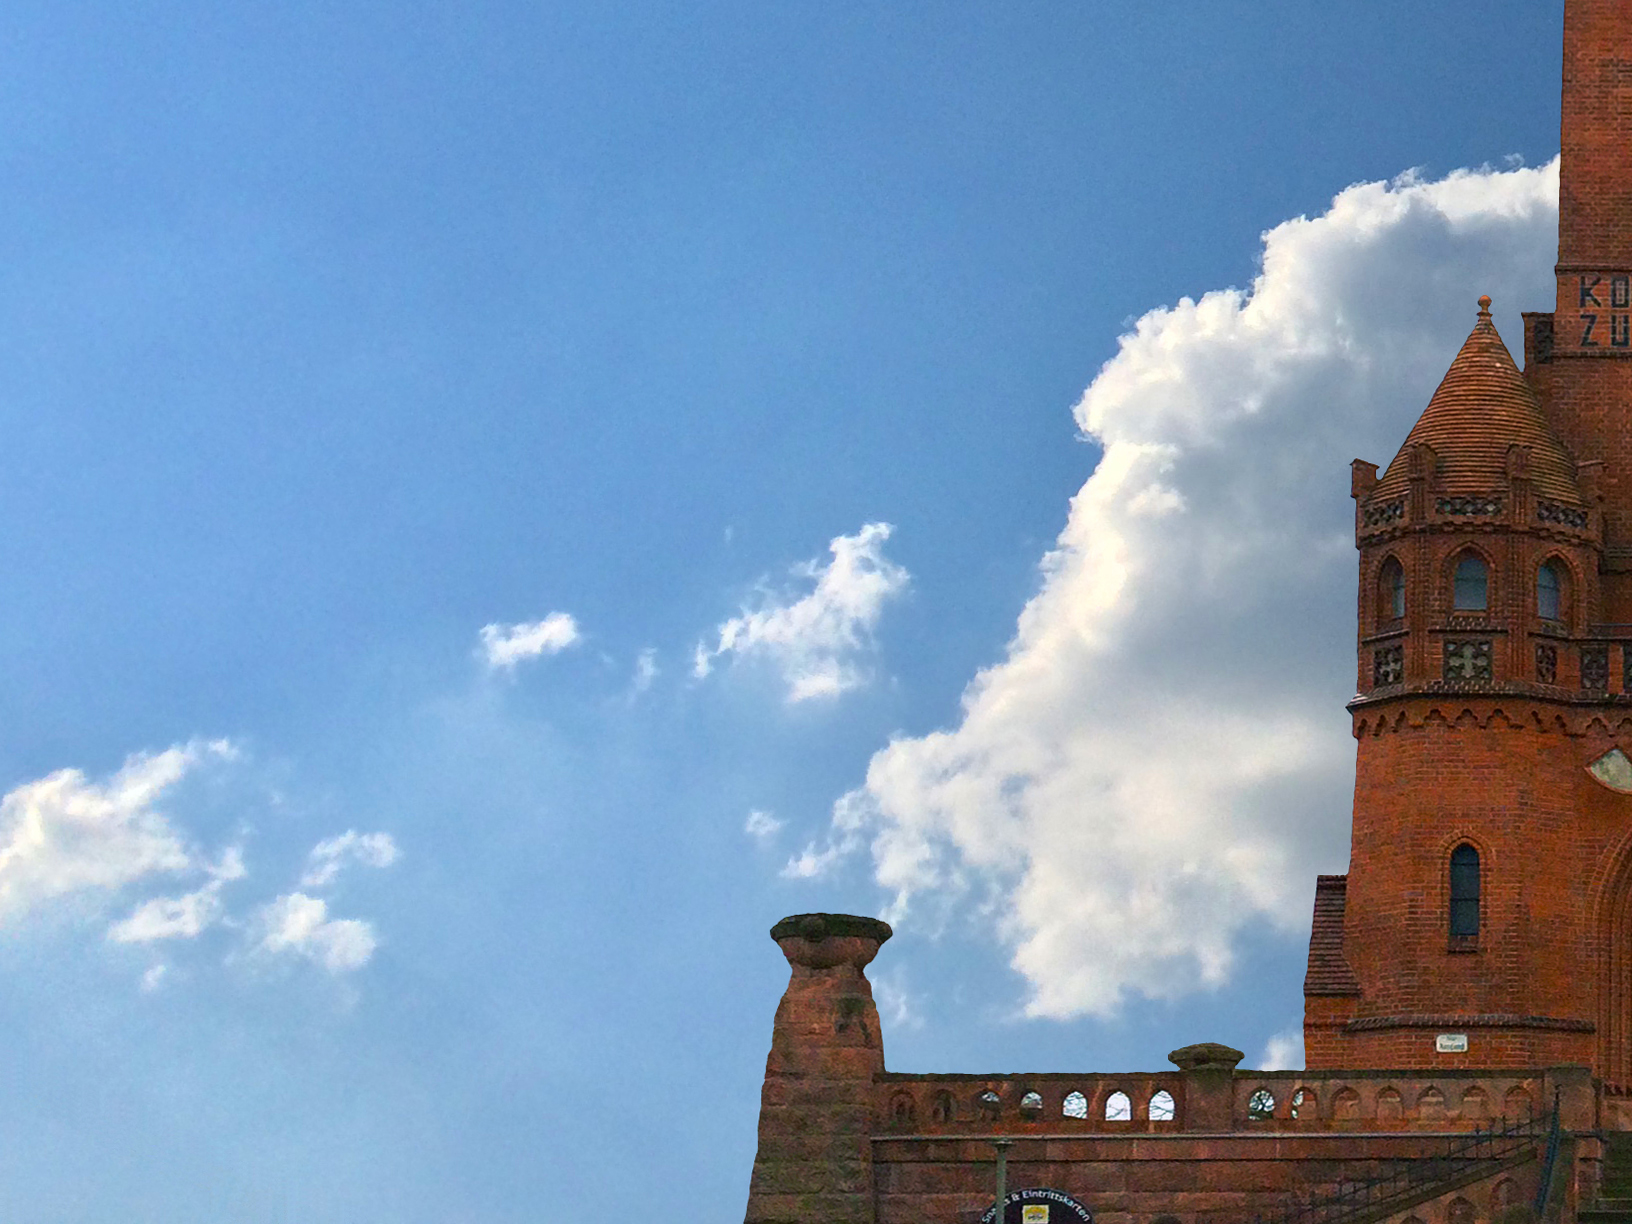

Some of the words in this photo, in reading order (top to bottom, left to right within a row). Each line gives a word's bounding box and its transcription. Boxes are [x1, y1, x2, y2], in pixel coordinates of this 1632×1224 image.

[982, 1198, 1010, 1223] Snas
[1011, 1193, 1020, 1201] &
[1022, 1190, 1090, 1221] Eintrittskarten
